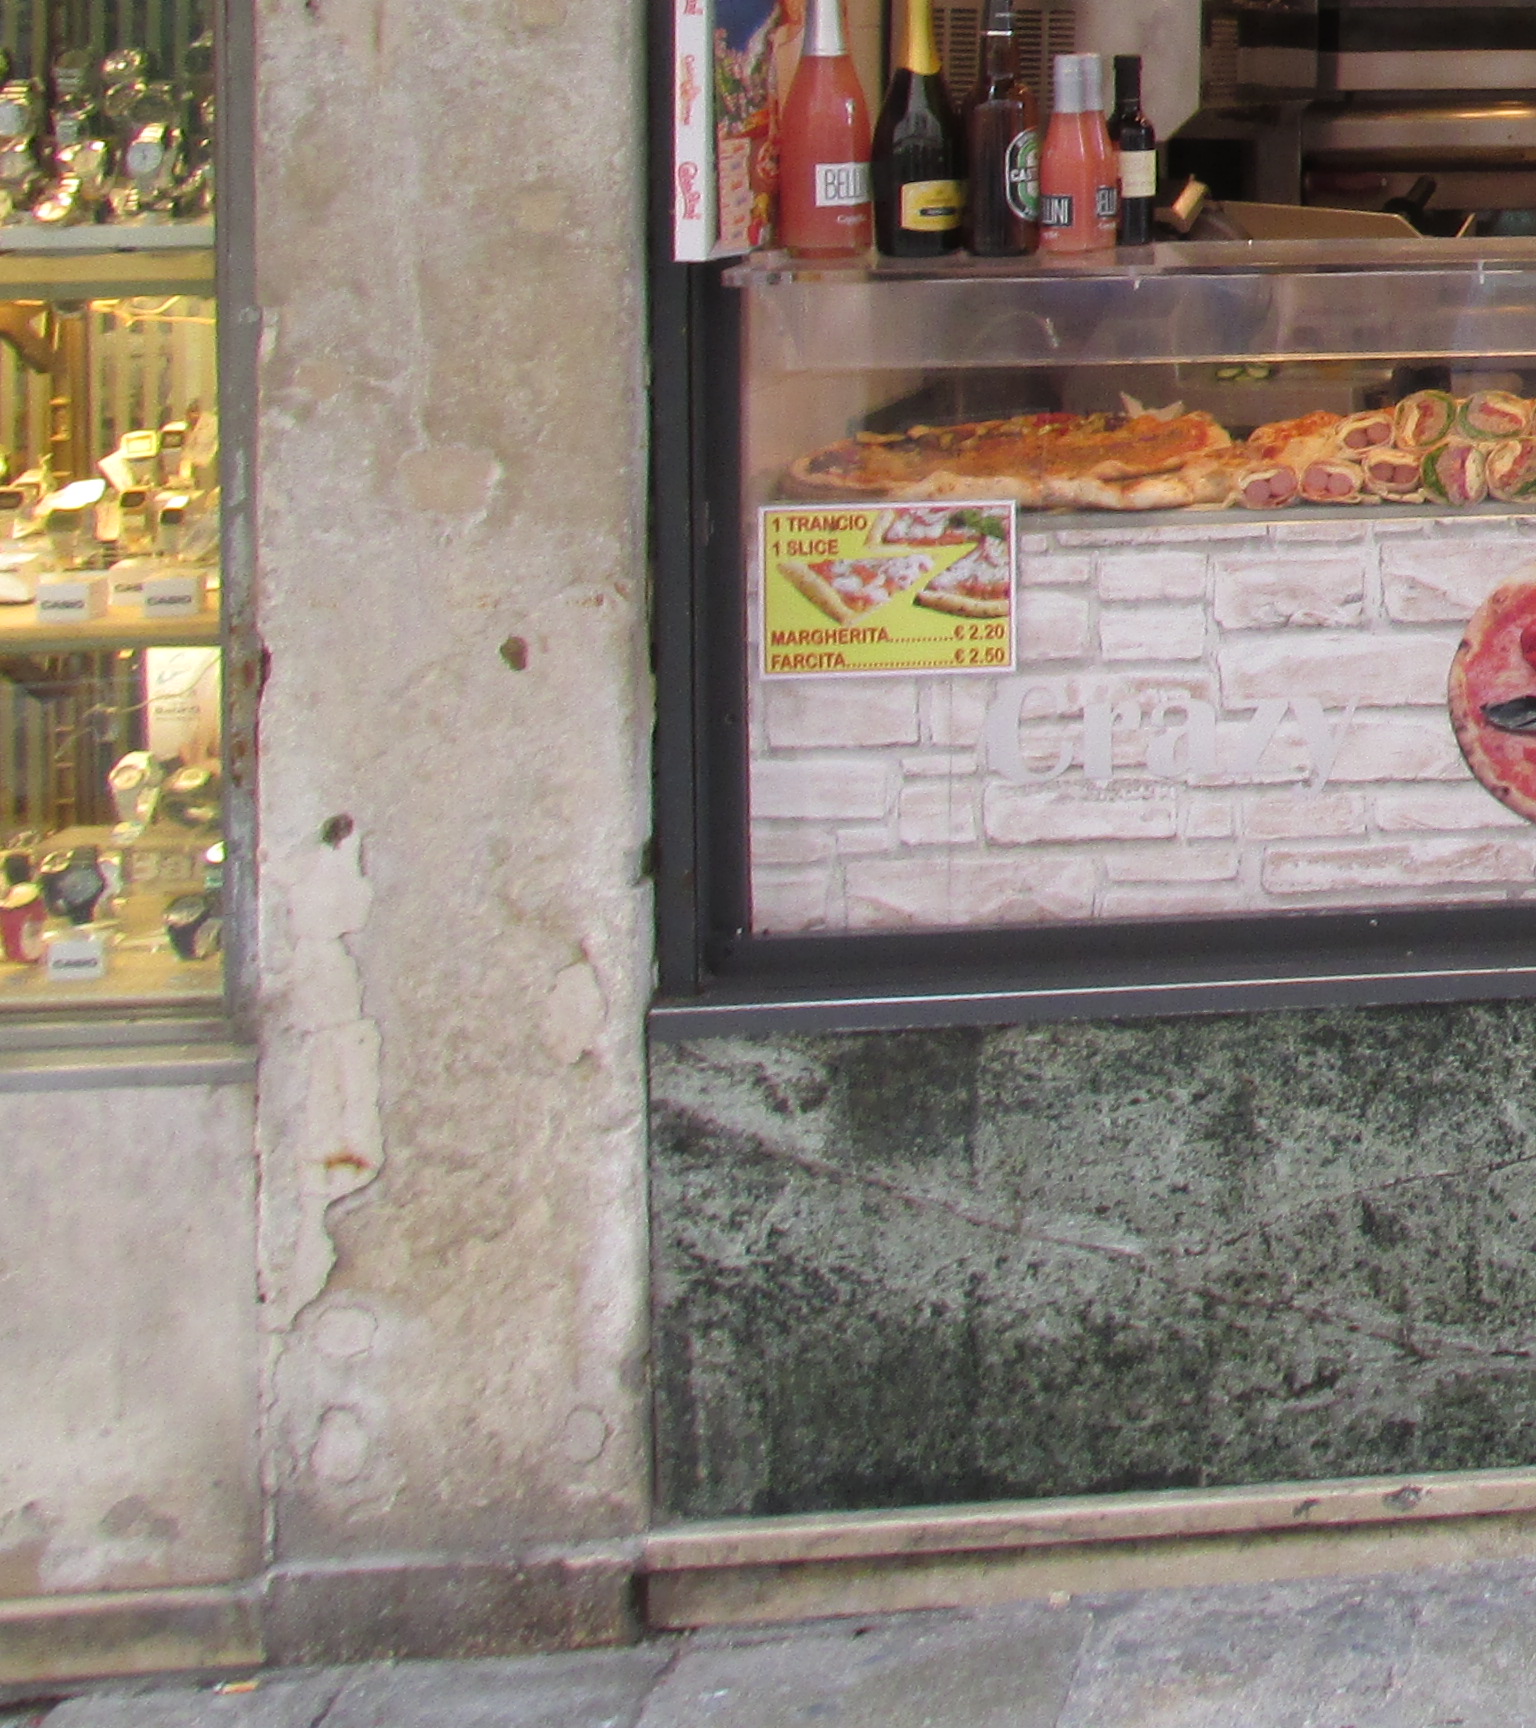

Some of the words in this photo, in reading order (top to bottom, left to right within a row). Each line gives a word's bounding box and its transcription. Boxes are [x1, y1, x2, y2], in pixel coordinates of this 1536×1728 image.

[772, 517, 781, 532] 1
[786, 515, 867, 532] TRANCIO
[772, 541, 780, 556] 1
[786, 538, 839, 556] SLICE
[953, 625, 965, 640] €
[969, 623, 1005, 640] 2.20
[954, 649, 966, 664] €
[970, 647, 1005, 664] 2.50
[986, 677, 1362, 799] Crazy
